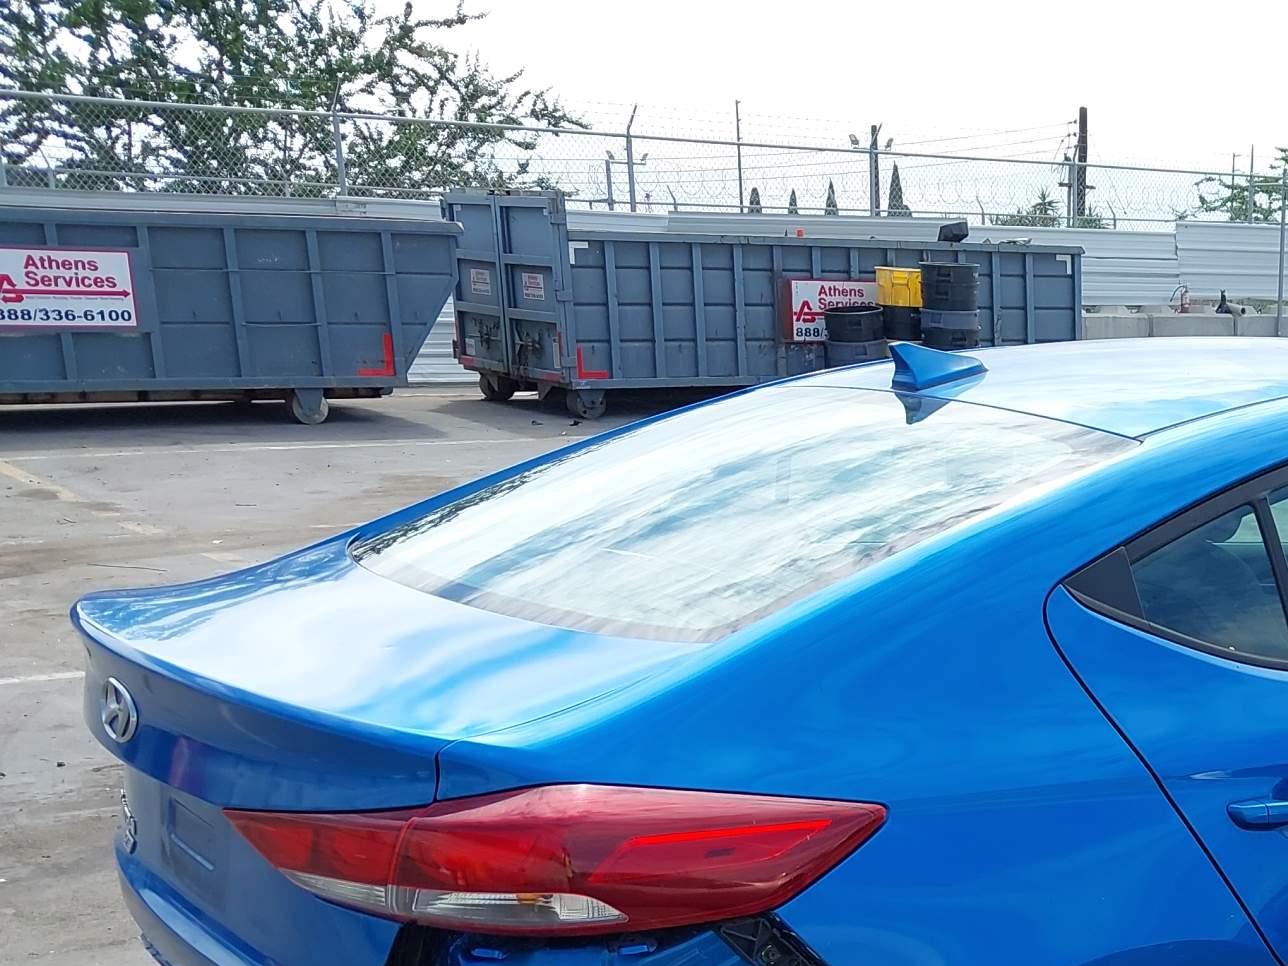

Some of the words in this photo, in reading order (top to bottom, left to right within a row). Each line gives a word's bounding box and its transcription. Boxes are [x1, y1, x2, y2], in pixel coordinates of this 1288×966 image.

[24, 254, 99, 271] Athens
[24, 270, 117, 289] Services
[818, 285, 865, 298] Athens
